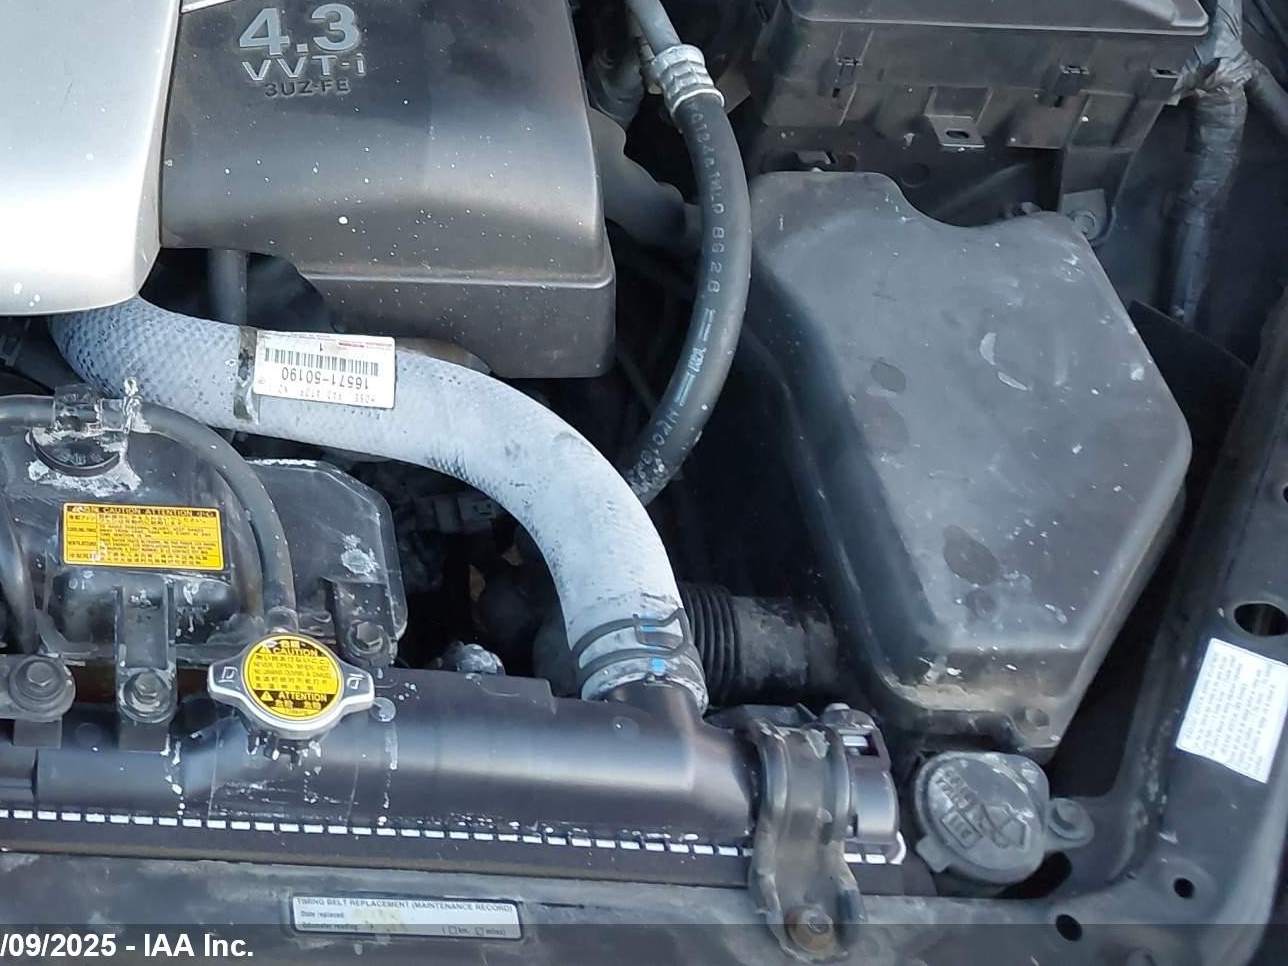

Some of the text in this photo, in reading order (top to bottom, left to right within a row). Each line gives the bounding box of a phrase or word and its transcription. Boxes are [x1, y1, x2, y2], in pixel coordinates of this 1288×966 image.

[239, 3, 360, 55] 4.3
[264, 78, 350, 97] 3UZ-FE
[281, 366, 369, 390] 16571-50190
[145, 508, 192, 517] ATTENTION
[273, 647, 318, 656] CAUTION
[278, 691, 328, 702] ATTENTION
[297, 898, 513, 913] TIMING BELT REPLACEMENT (MAINTENANCE RECORD)
